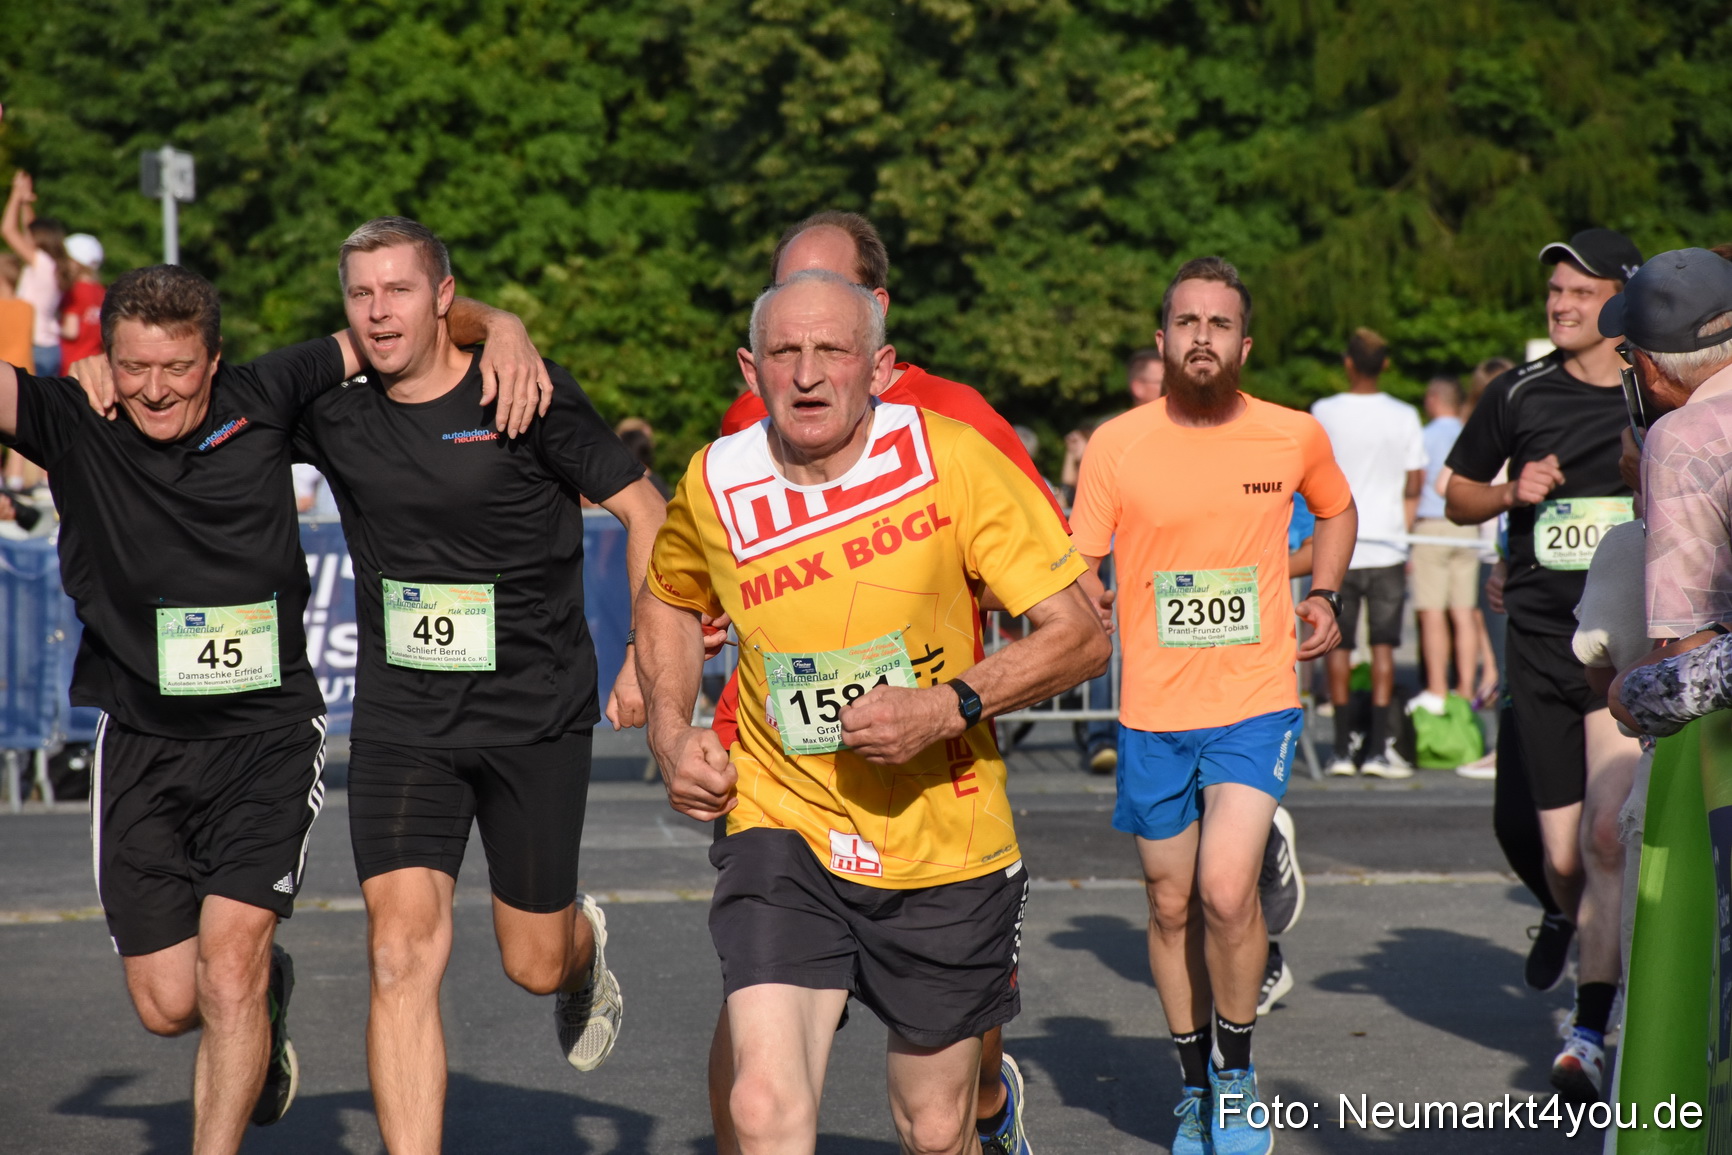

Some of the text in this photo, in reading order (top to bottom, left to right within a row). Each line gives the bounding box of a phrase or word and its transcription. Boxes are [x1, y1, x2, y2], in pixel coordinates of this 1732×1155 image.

[198, 419, 237, 451] autoladen
[442, 429, 490, 440] autoladen
[1243, 481, 1282, 494] THULE
[1547, 524, 1616, 550] 200
[739, 502, 952, 611] MAX BÖGL
[465, 607, 487, 615] 2019
[1167, 595, 1246, 626] 2309
[177, 624, 224, 634] firmenlauf
[252, 625, 271, 635] 2019
[412, 615, 455, 646] 49
[1168, 624, 1249, 635] Prantl-Frunzo Tobias
[197, 638, 243, 669] 45
[406, 645, 466, 656] Schlierf Bernd
[178, 666, 263, 680] Damaschke Erfried
[786, 669, 839, 683] firmenlauf
[875, 659, 900, 675] 2019
[232, 676, 249, 684] GmbH
[816, 724, 841, 735] Graf
[818, 735, 836, 745] Bögl
